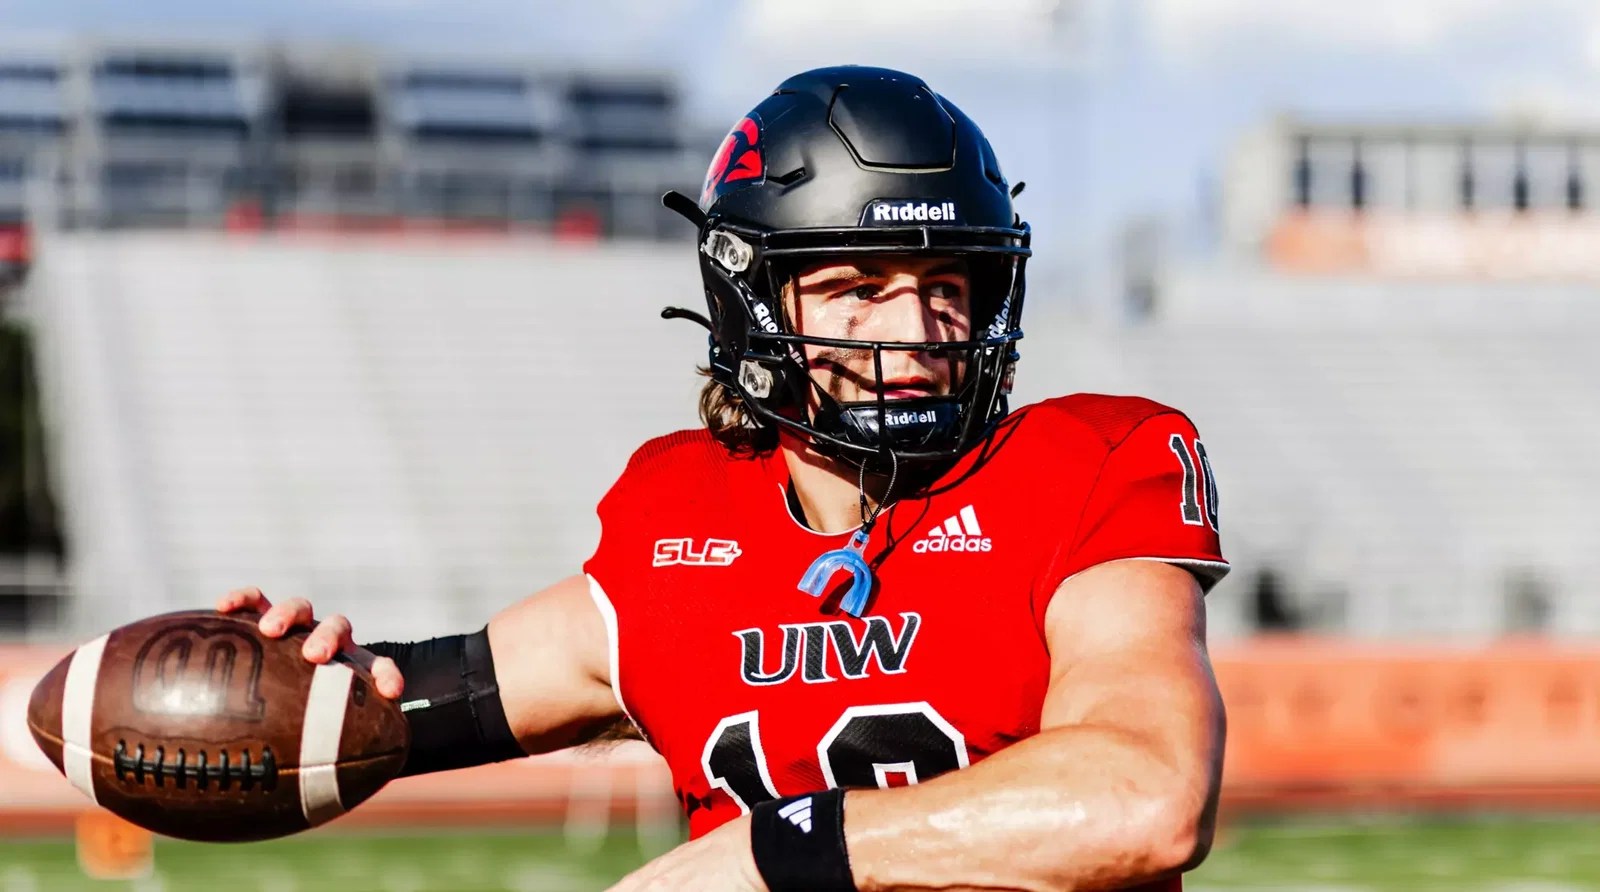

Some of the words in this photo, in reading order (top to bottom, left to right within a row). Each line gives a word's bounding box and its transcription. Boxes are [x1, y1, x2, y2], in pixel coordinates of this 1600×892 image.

[873, 202, 956, 221] Riddell
[884, 410, 937, 426] Riddell
[652, 537, 742, 568] SLC
[912, 533, 992, 553] adidas
[731, 611, 922, 687] UIW
